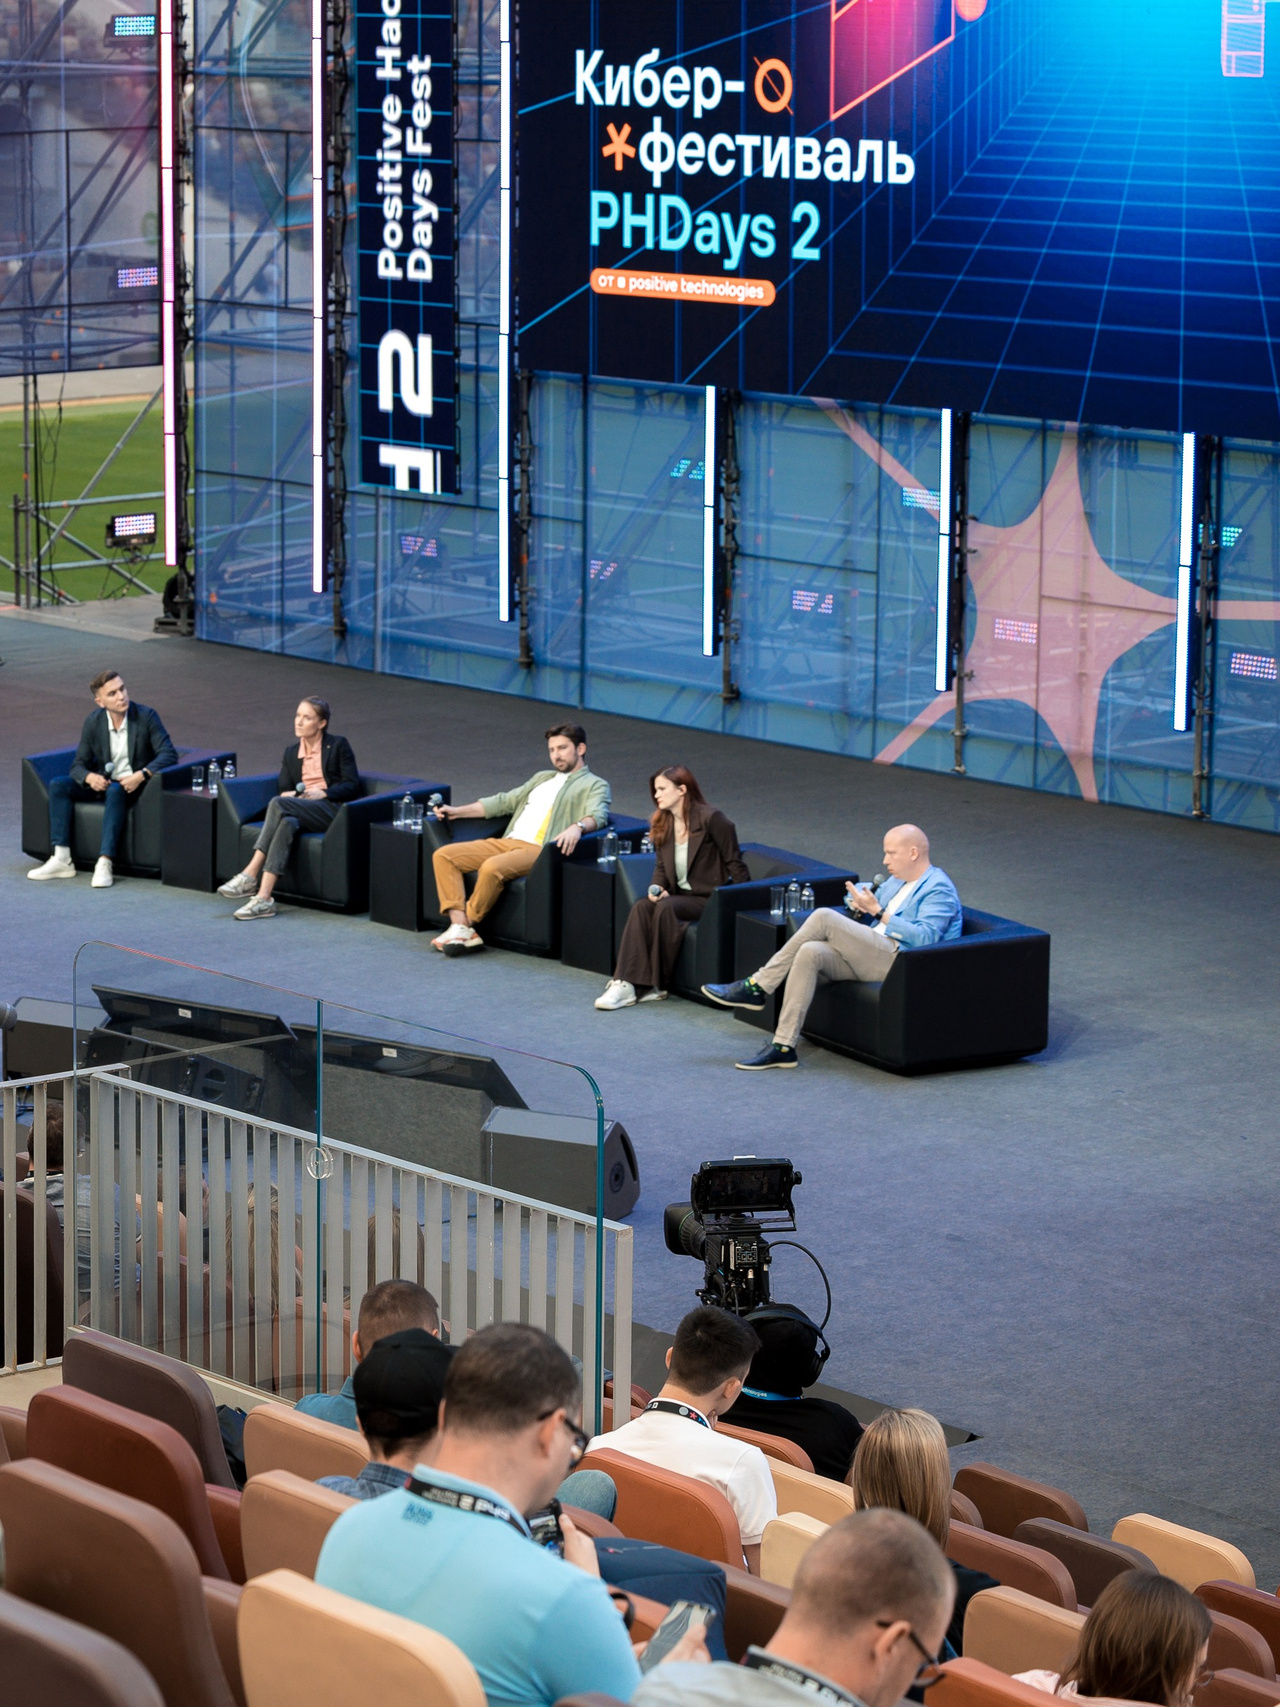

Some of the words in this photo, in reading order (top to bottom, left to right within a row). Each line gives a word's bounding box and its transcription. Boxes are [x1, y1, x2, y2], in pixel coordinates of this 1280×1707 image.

[405, 54, 432, 156] Fest
[575, 48, 745, 118] Кибер-
[376, 93, 404, 280] Positive
[406, 169, 439, 283] Days
[589, 190, 777, 271] PHDays
[791, 201, 821, 261] 2
[629, 276, 679, 292] positive
[680, 279, 764, 302] technologies
[377, 328, 433, 419] 2
